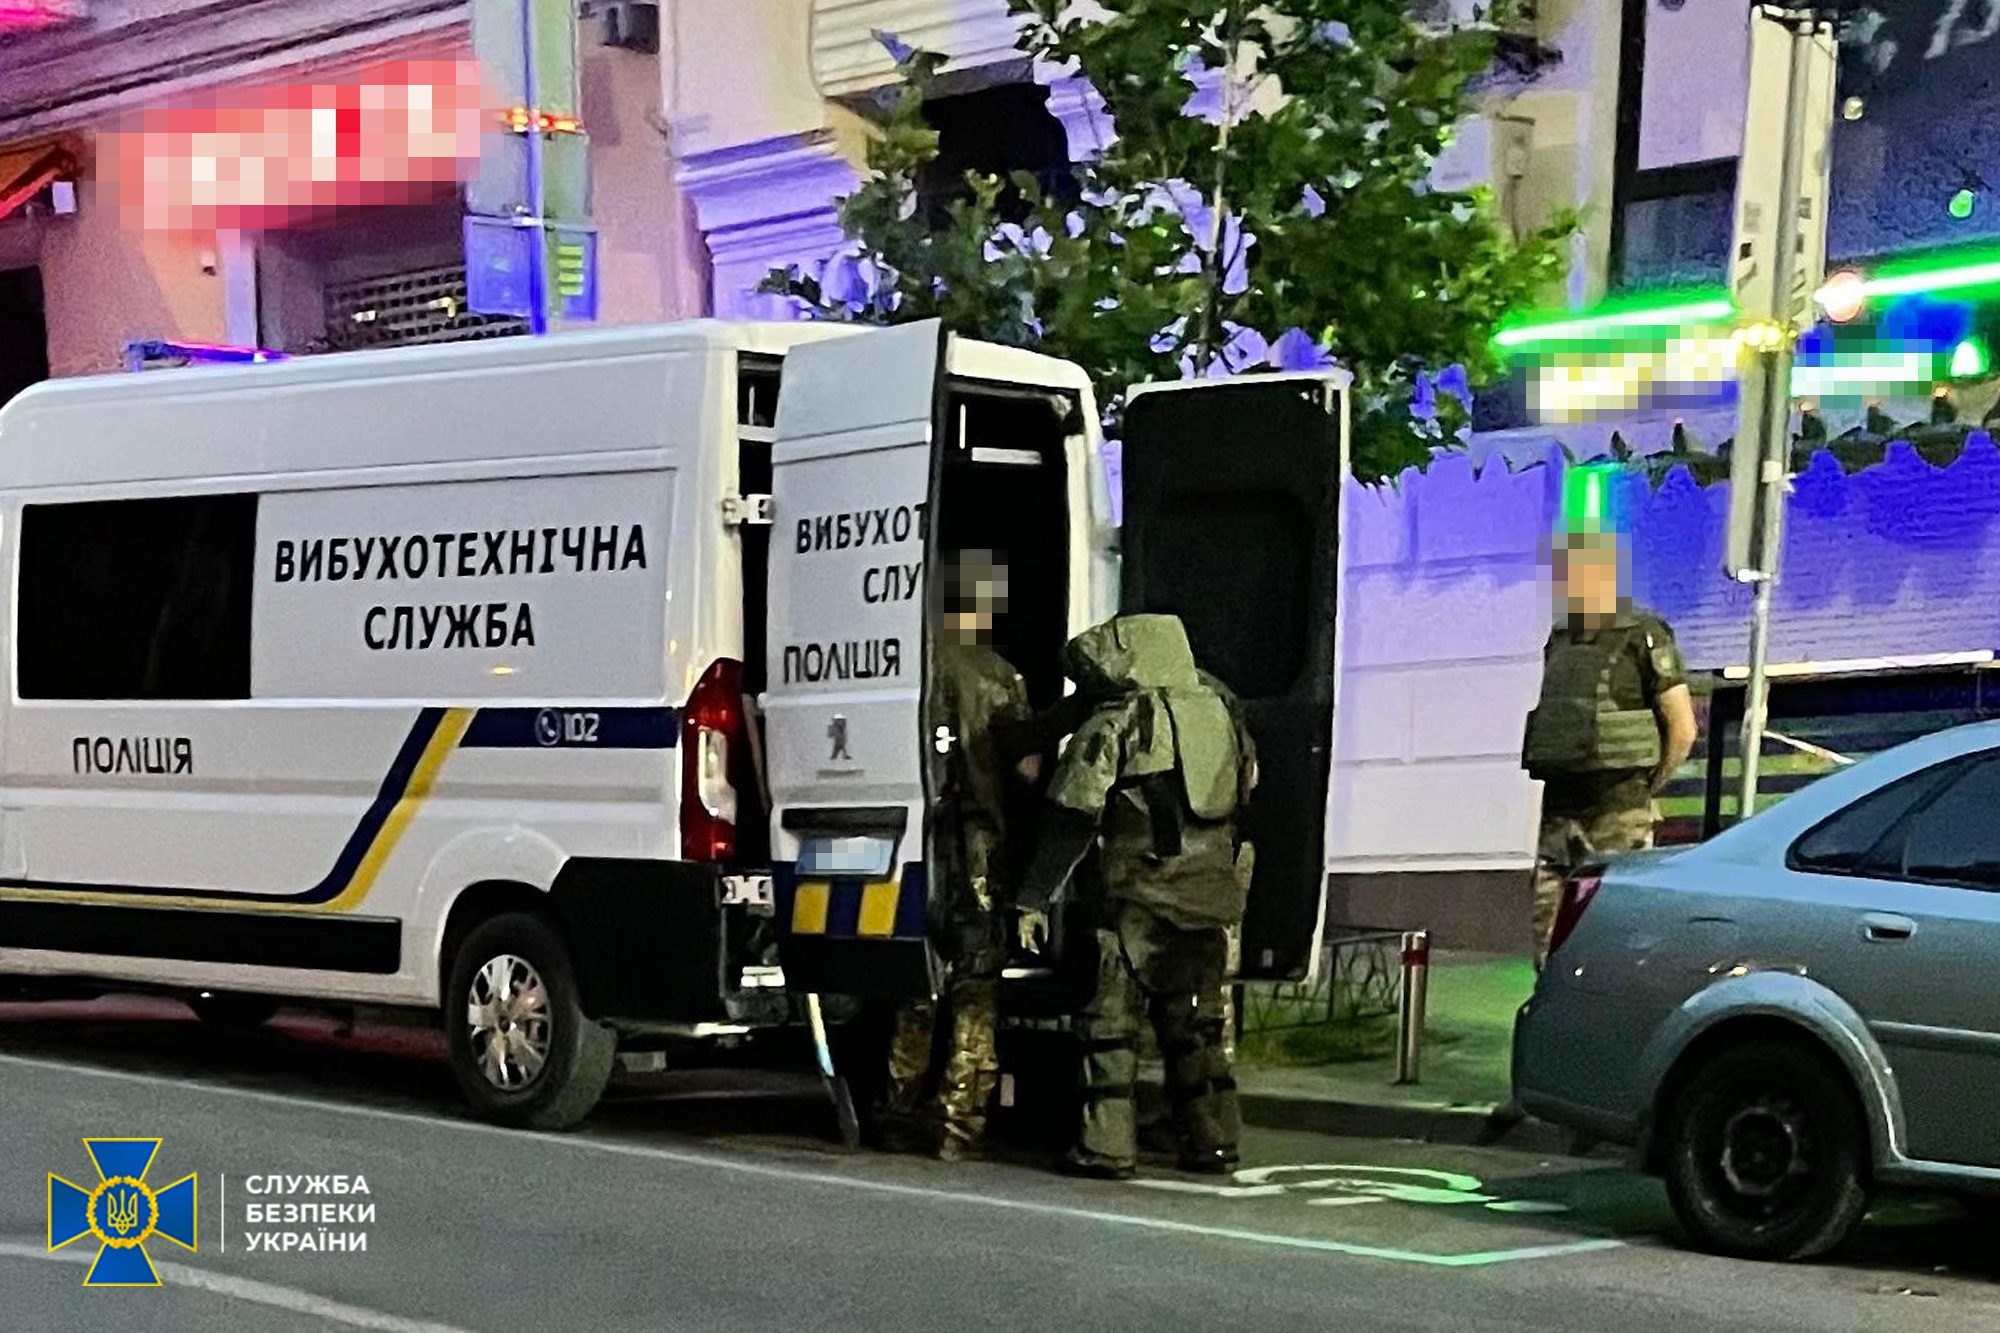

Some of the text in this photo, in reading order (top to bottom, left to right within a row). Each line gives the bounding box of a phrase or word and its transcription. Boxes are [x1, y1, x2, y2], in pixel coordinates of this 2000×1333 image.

[275, 524, 647, 582] ВИБУХОТЕХНІЧНА
[364, 602, 535, 650] СЛУЖБА
[784, 637, 900, 685] ПОЛІЦІЯ
[563, 712, 600, 742] 102
[73, 736, 193, 774] ПОЛІЦІЯ
